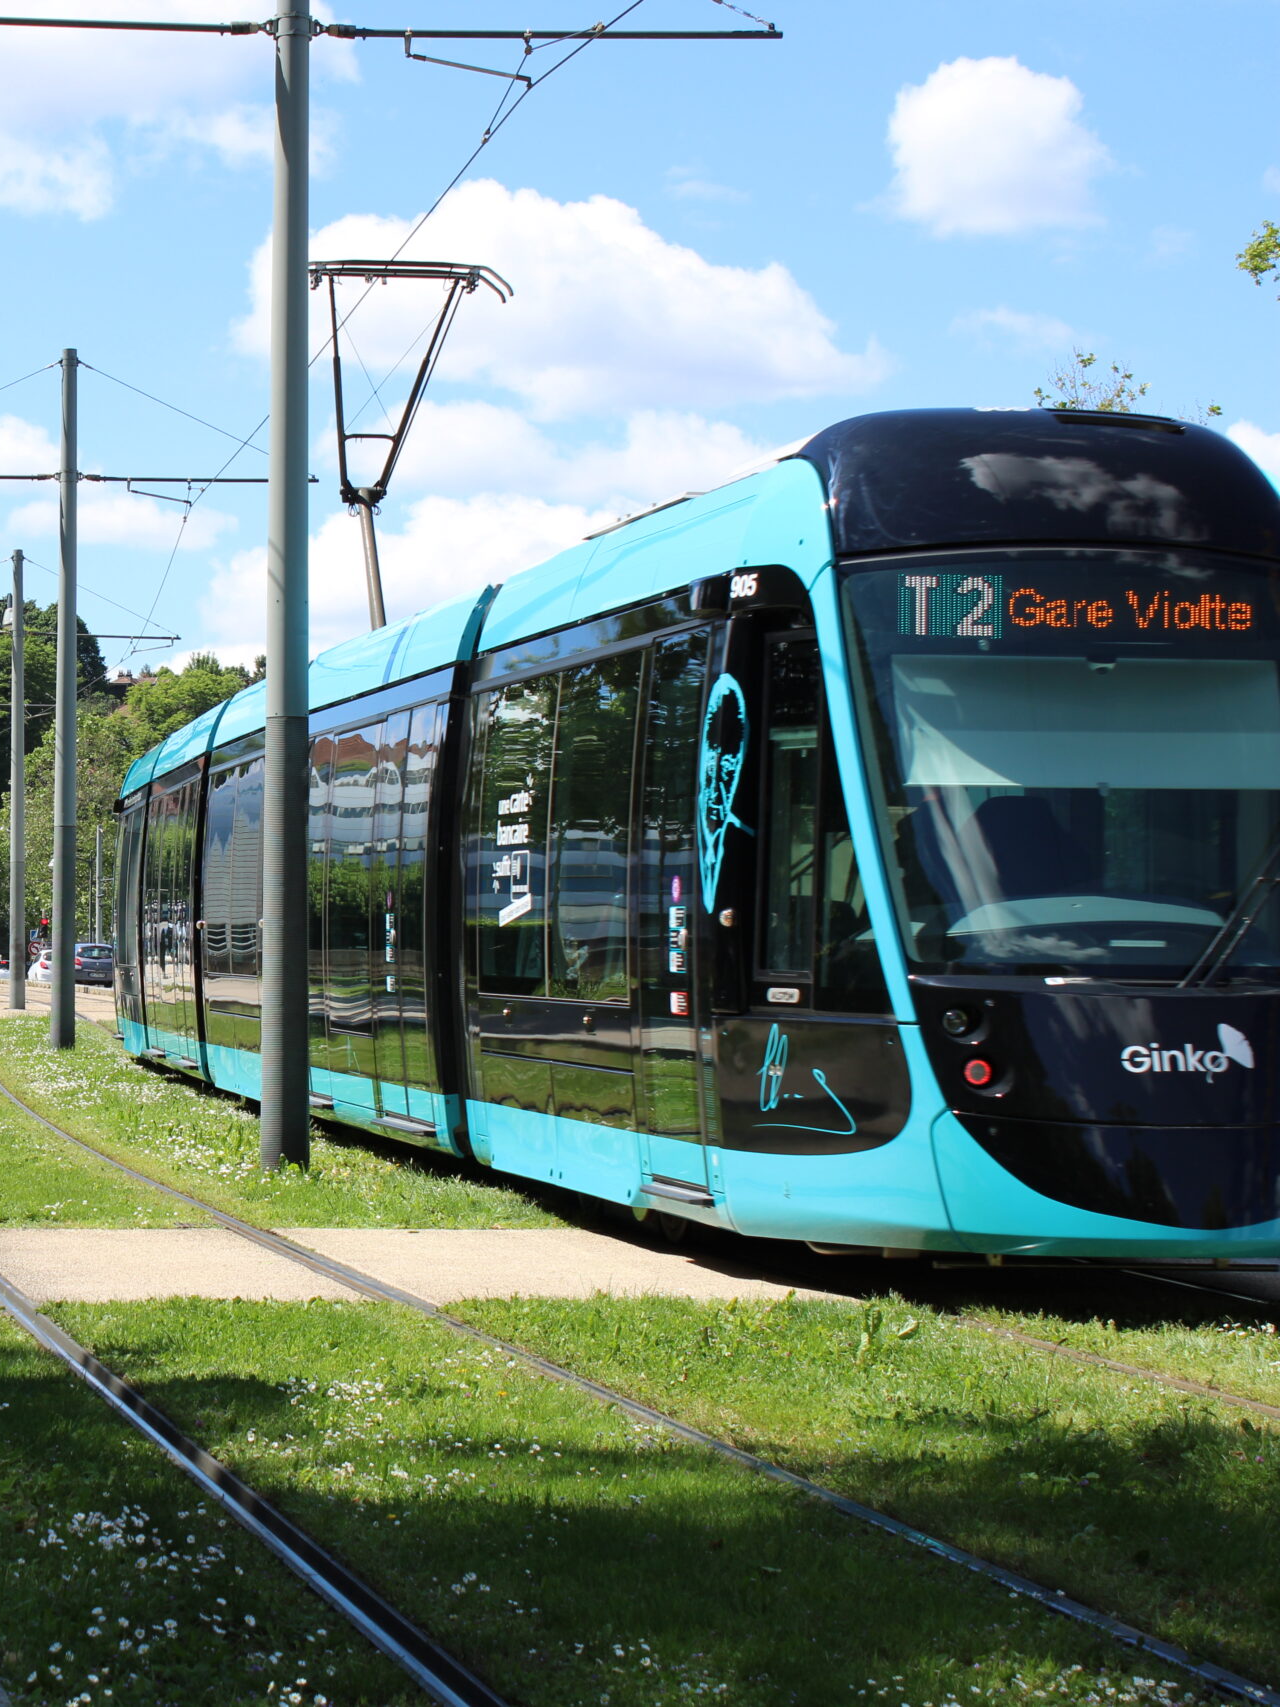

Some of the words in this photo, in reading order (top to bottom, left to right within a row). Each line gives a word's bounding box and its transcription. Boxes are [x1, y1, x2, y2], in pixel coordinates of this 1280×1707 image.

[730, 573, 758, 598] 905
[1008, 587, 1113, 628] Gare
[1120, 1042, 1231, 1078] Ginko
